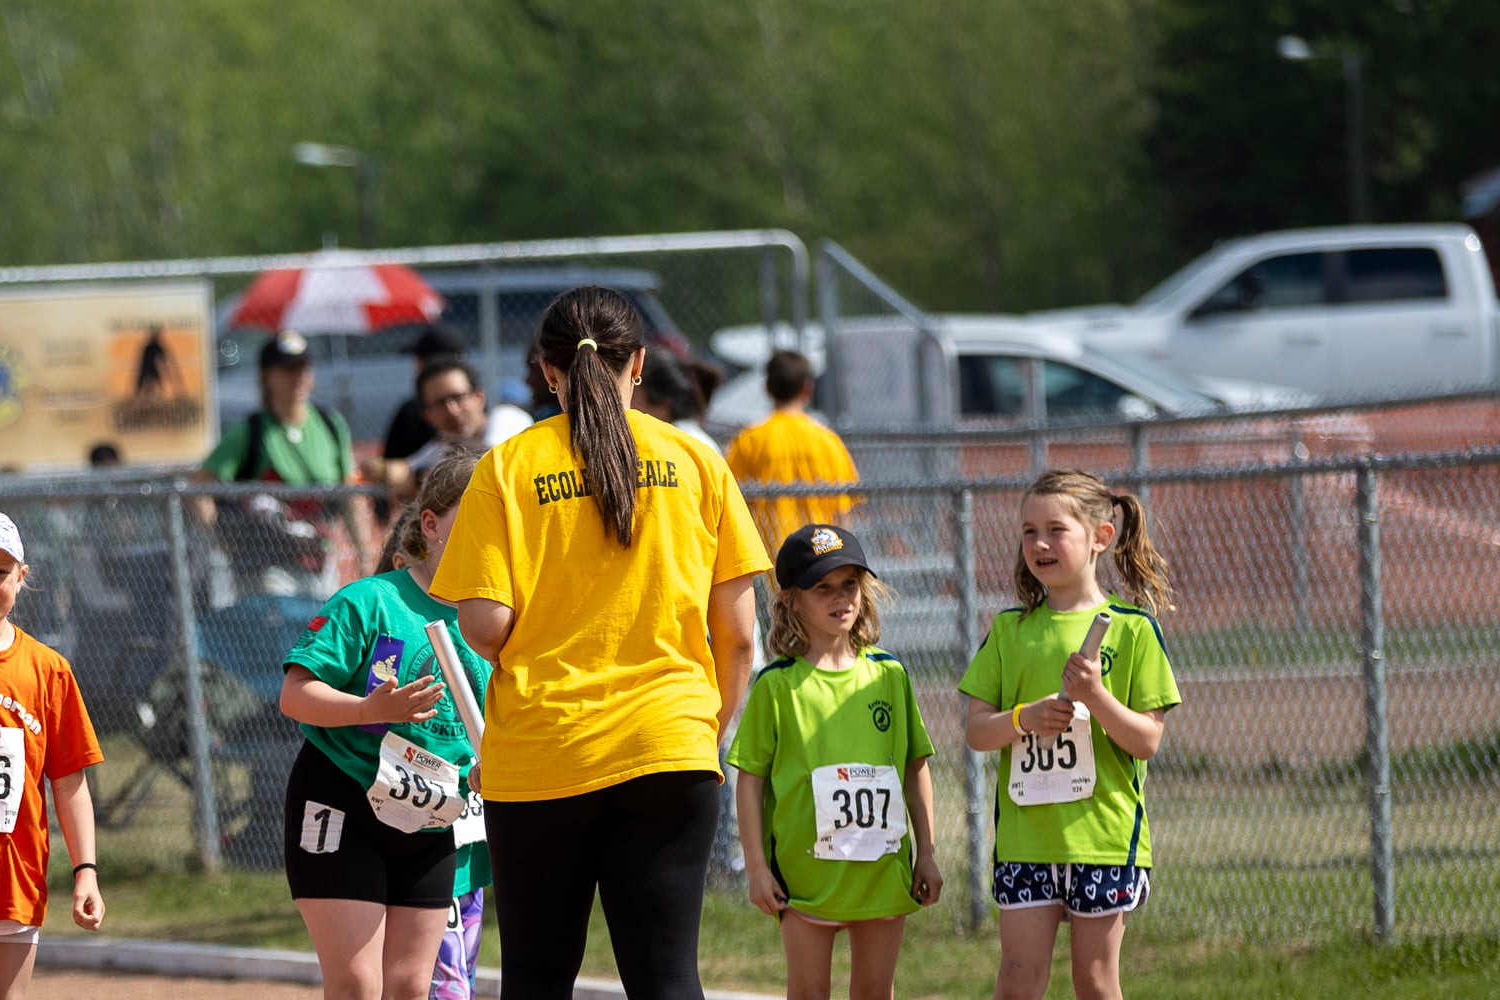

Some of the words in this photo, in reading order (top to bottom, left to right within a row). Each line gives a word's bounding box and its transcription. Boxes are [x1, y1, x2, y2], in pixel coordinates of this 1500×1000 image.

[415, 753, 442, 769] POWER
[1021, 726, 1077, 773] 305
[850, 767, 876, 776] POWER
[832, 788, 890, 829] 307
[314, 809, 331, 852] 1
